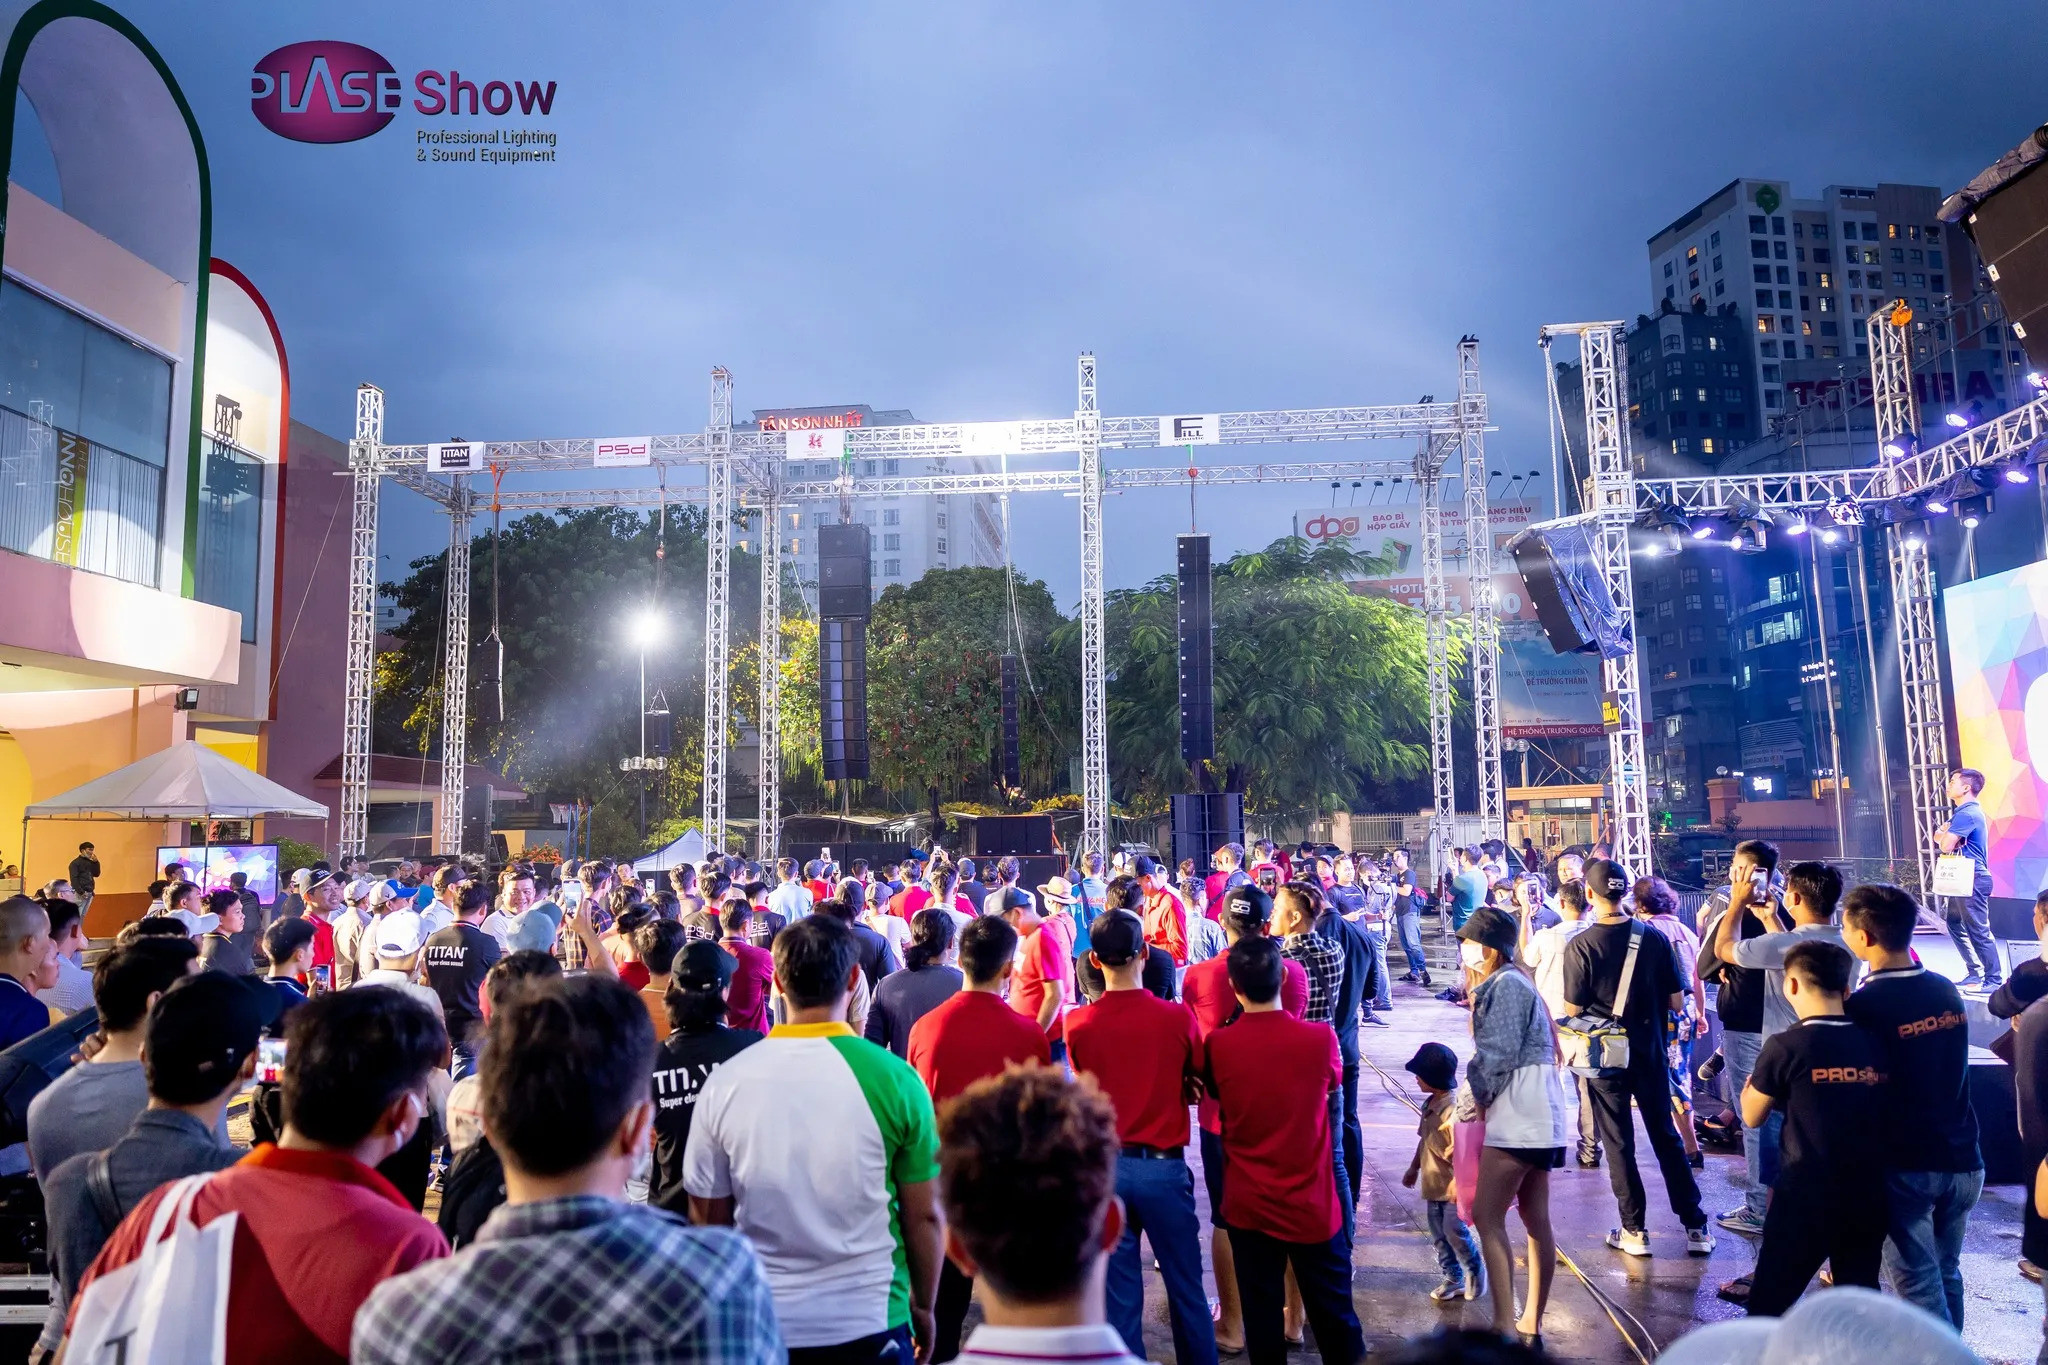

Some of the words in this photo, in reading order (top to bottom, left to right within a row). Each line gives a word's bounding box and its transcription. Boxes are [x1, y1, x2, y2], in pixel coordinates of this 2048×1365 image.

[1786, 371, 1997, 410] TOSIBA
[442, 448, 468, 458] TITAN
[1487, 506, 1507, 515] ẢNG
[1372, 514, 1393, 522] BAO
[1389, 582, 1453, 594] HOTLE:
[428, 945, 465, 959] TITAN
[652, 1062, 720, 1094] TIT
[660, 1096, 683, 1109] Super
[684, 1093, 699, 1105] cle
